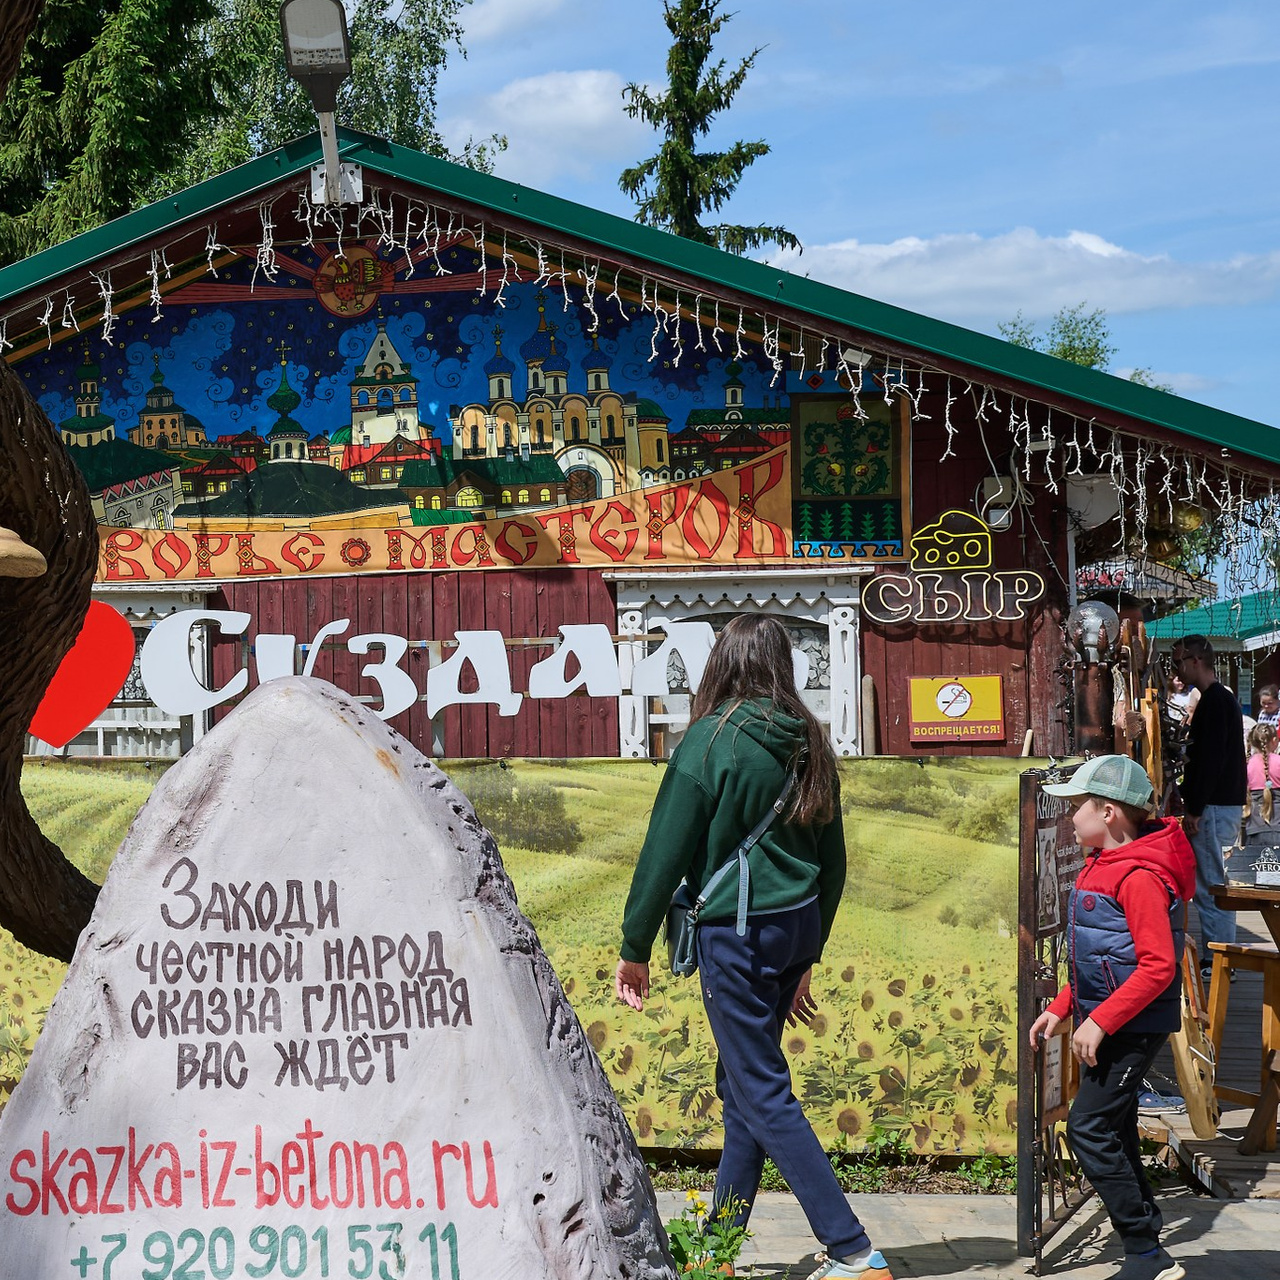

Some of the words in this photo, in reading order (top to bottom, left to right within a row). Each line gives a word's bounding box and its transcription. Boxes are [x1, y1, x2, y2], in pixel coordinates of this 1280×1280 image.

[96, 529, 326, 581] ВОРЬЕ
[385, 450, 788, 570] МАСТЕРОВ
[861, 570, 1045, 623] СЫР
[140, 608, 809, 720] Суздал
[913, 724, 1001, 736] ВОСПРЕЩАЕТСЯ!
[323, 931, 454, 985] НАРОД
[6, 1118, 499, 1217] skazka-iz-betona.ru
[243, 1225, 330, 1280] 901
